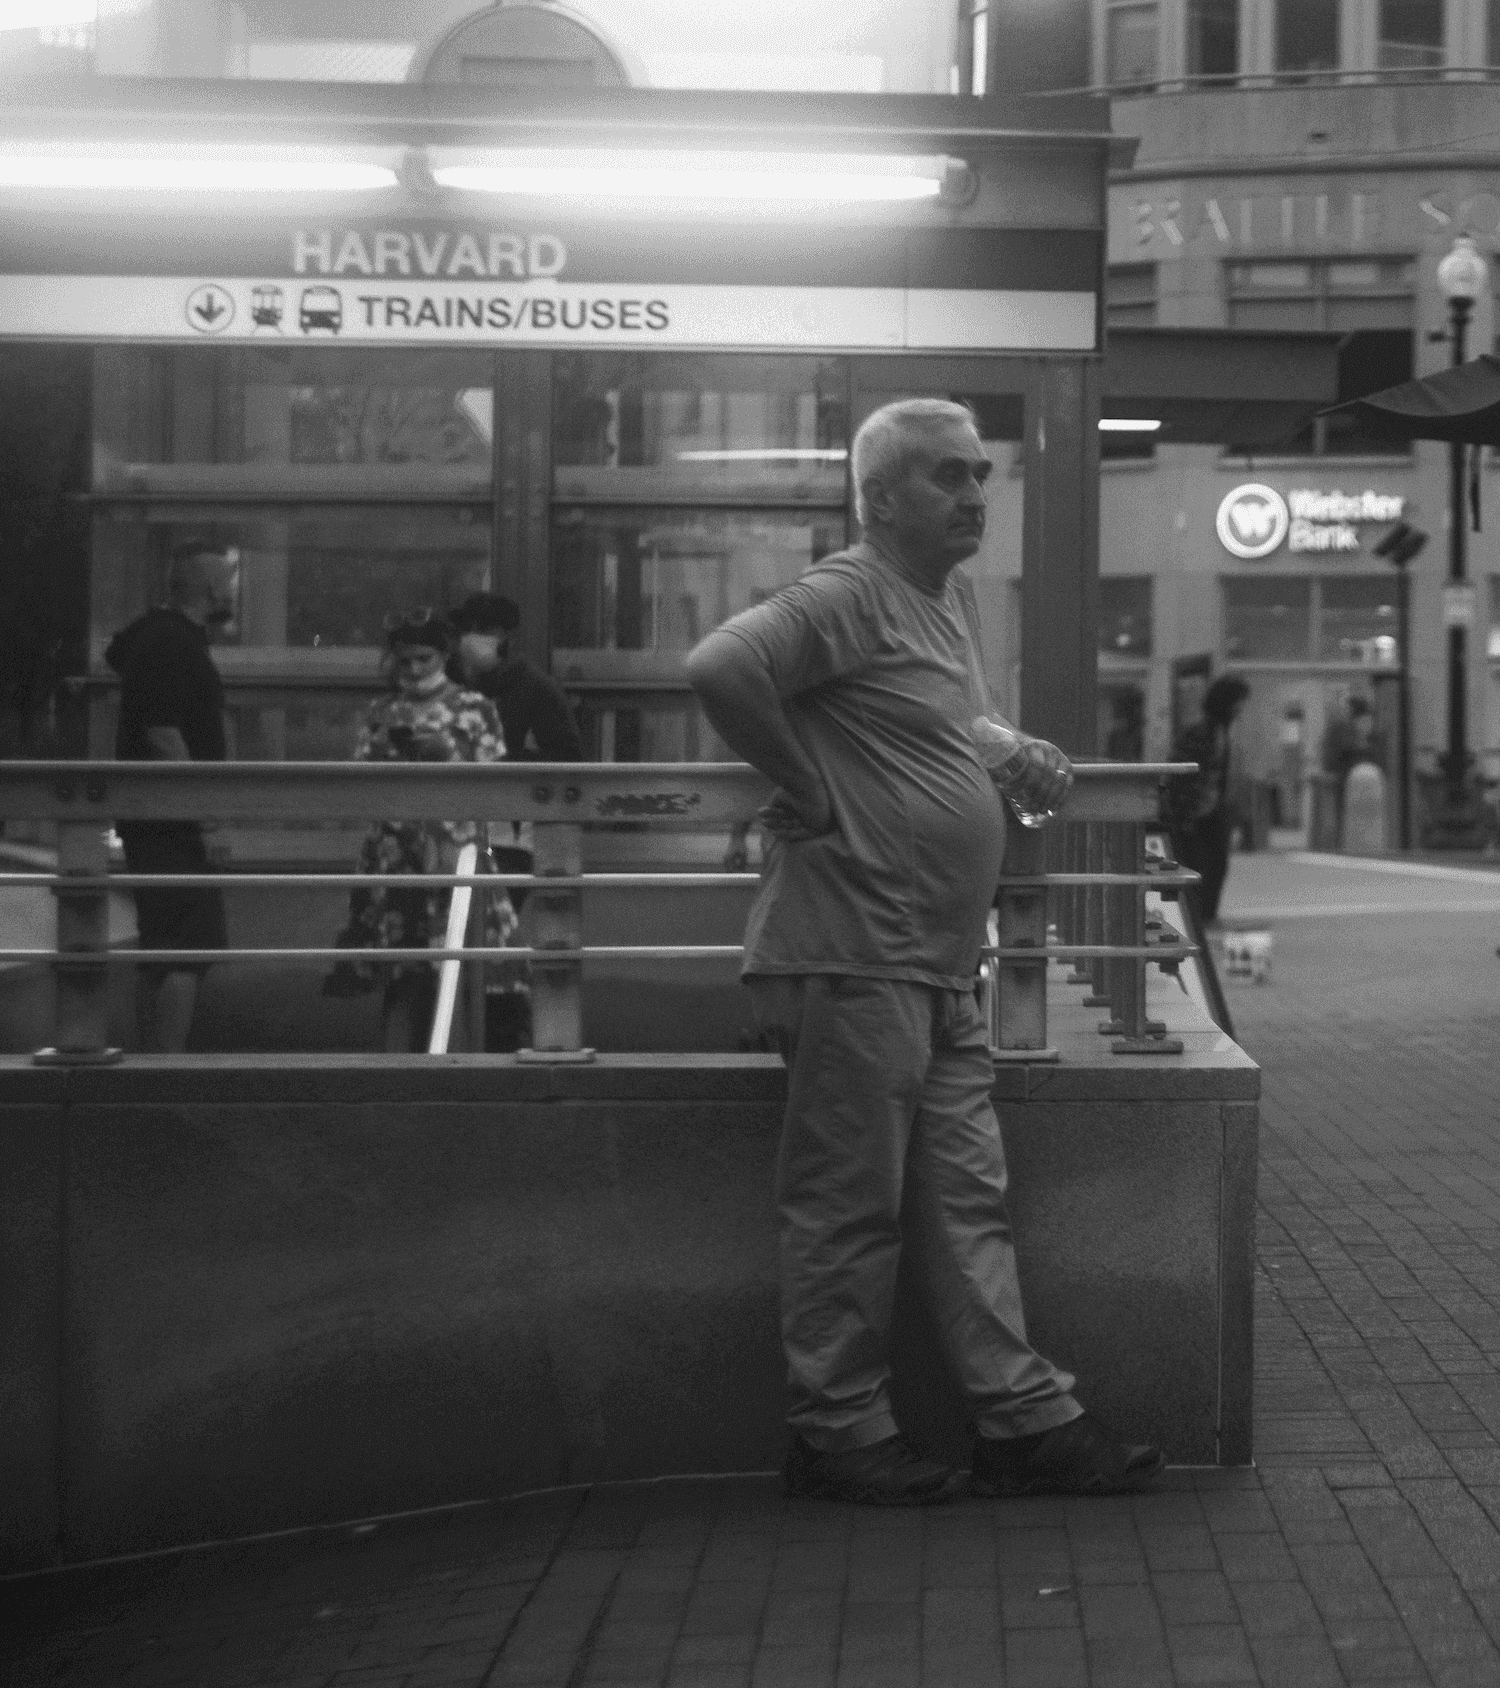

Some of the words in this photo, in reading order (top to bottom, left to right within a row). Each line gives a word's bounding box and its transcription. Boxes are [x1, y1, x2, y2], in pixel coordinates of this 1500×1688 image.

[292, 230, 568, 278] HARVARD
[357, 295, 670, 331] TRAINS/BUSES
[1288, 490, 1405, 520] Webster
[1288, 518, 1360, 550] Bank
